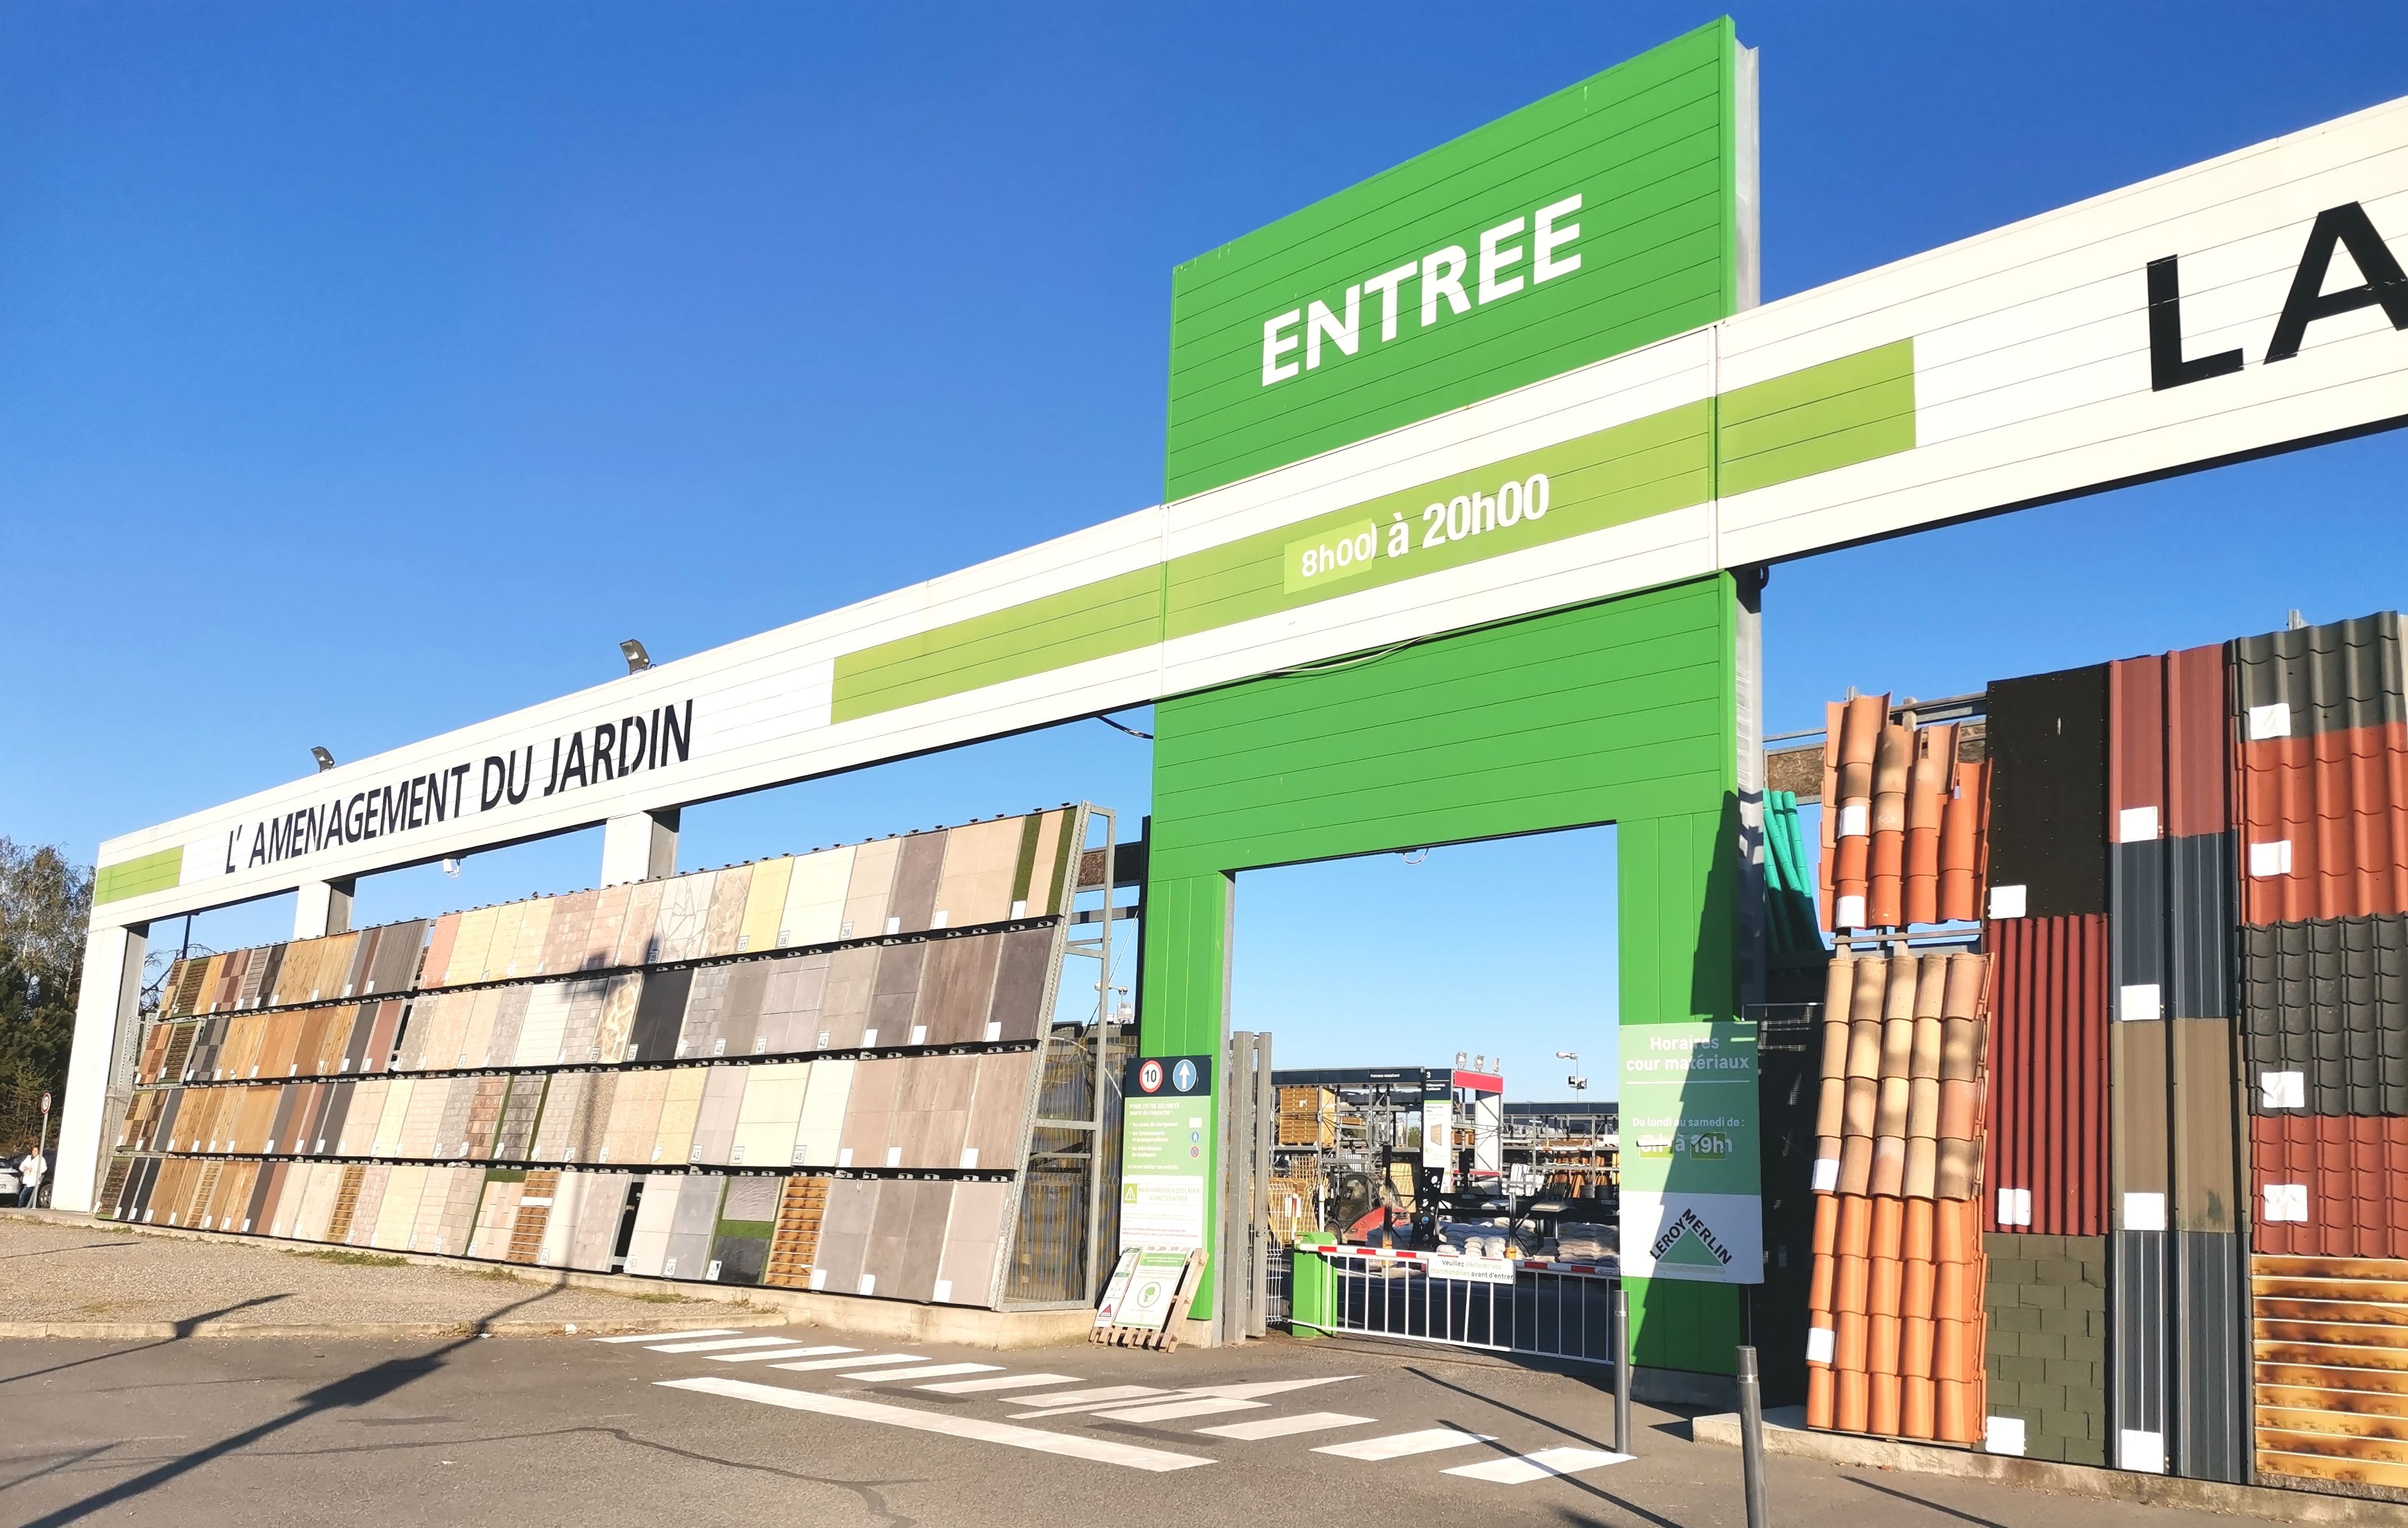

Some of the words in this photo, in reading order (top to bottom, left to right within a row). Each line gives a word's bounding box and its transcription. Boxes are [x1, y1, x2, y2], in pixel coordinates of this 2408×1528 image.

[1262, 193, 1582, 387] ENTREE
[2147, 201, 2408, 392] LA
[1387, 512, 1410, 558] à
[1422, 473, 1549, 549] 20h00
[225, 824, 242, 874] L'
[248, 762, 471, 869] AMENAGEMENT
[481, 745, 533, 811] DU
[544, 699, 693, 796] JARDIN
[1650, 1035, 1719, 1050] Horaires
[1626, 1059, 1661, 1071] cour
[1665, 1055, 1749, 1070] matériaux
[1145, 1069, 1157, 1083] 10
[1632, 1118, 1645, 1126] Du
[1647, 1117, 1672, 1126] lundi
[1688, 1117, 1725, 1126] samedi
[1727, 1117, 1739, 1126] de
[1649, 1217, 1686, 1261] LEROY
[1682, 1208, 1732, 1264] MERLIN
[1430, 1268, 1470, 1277] marchandises
[1466, 1261, 1490, 1269] déclarer
